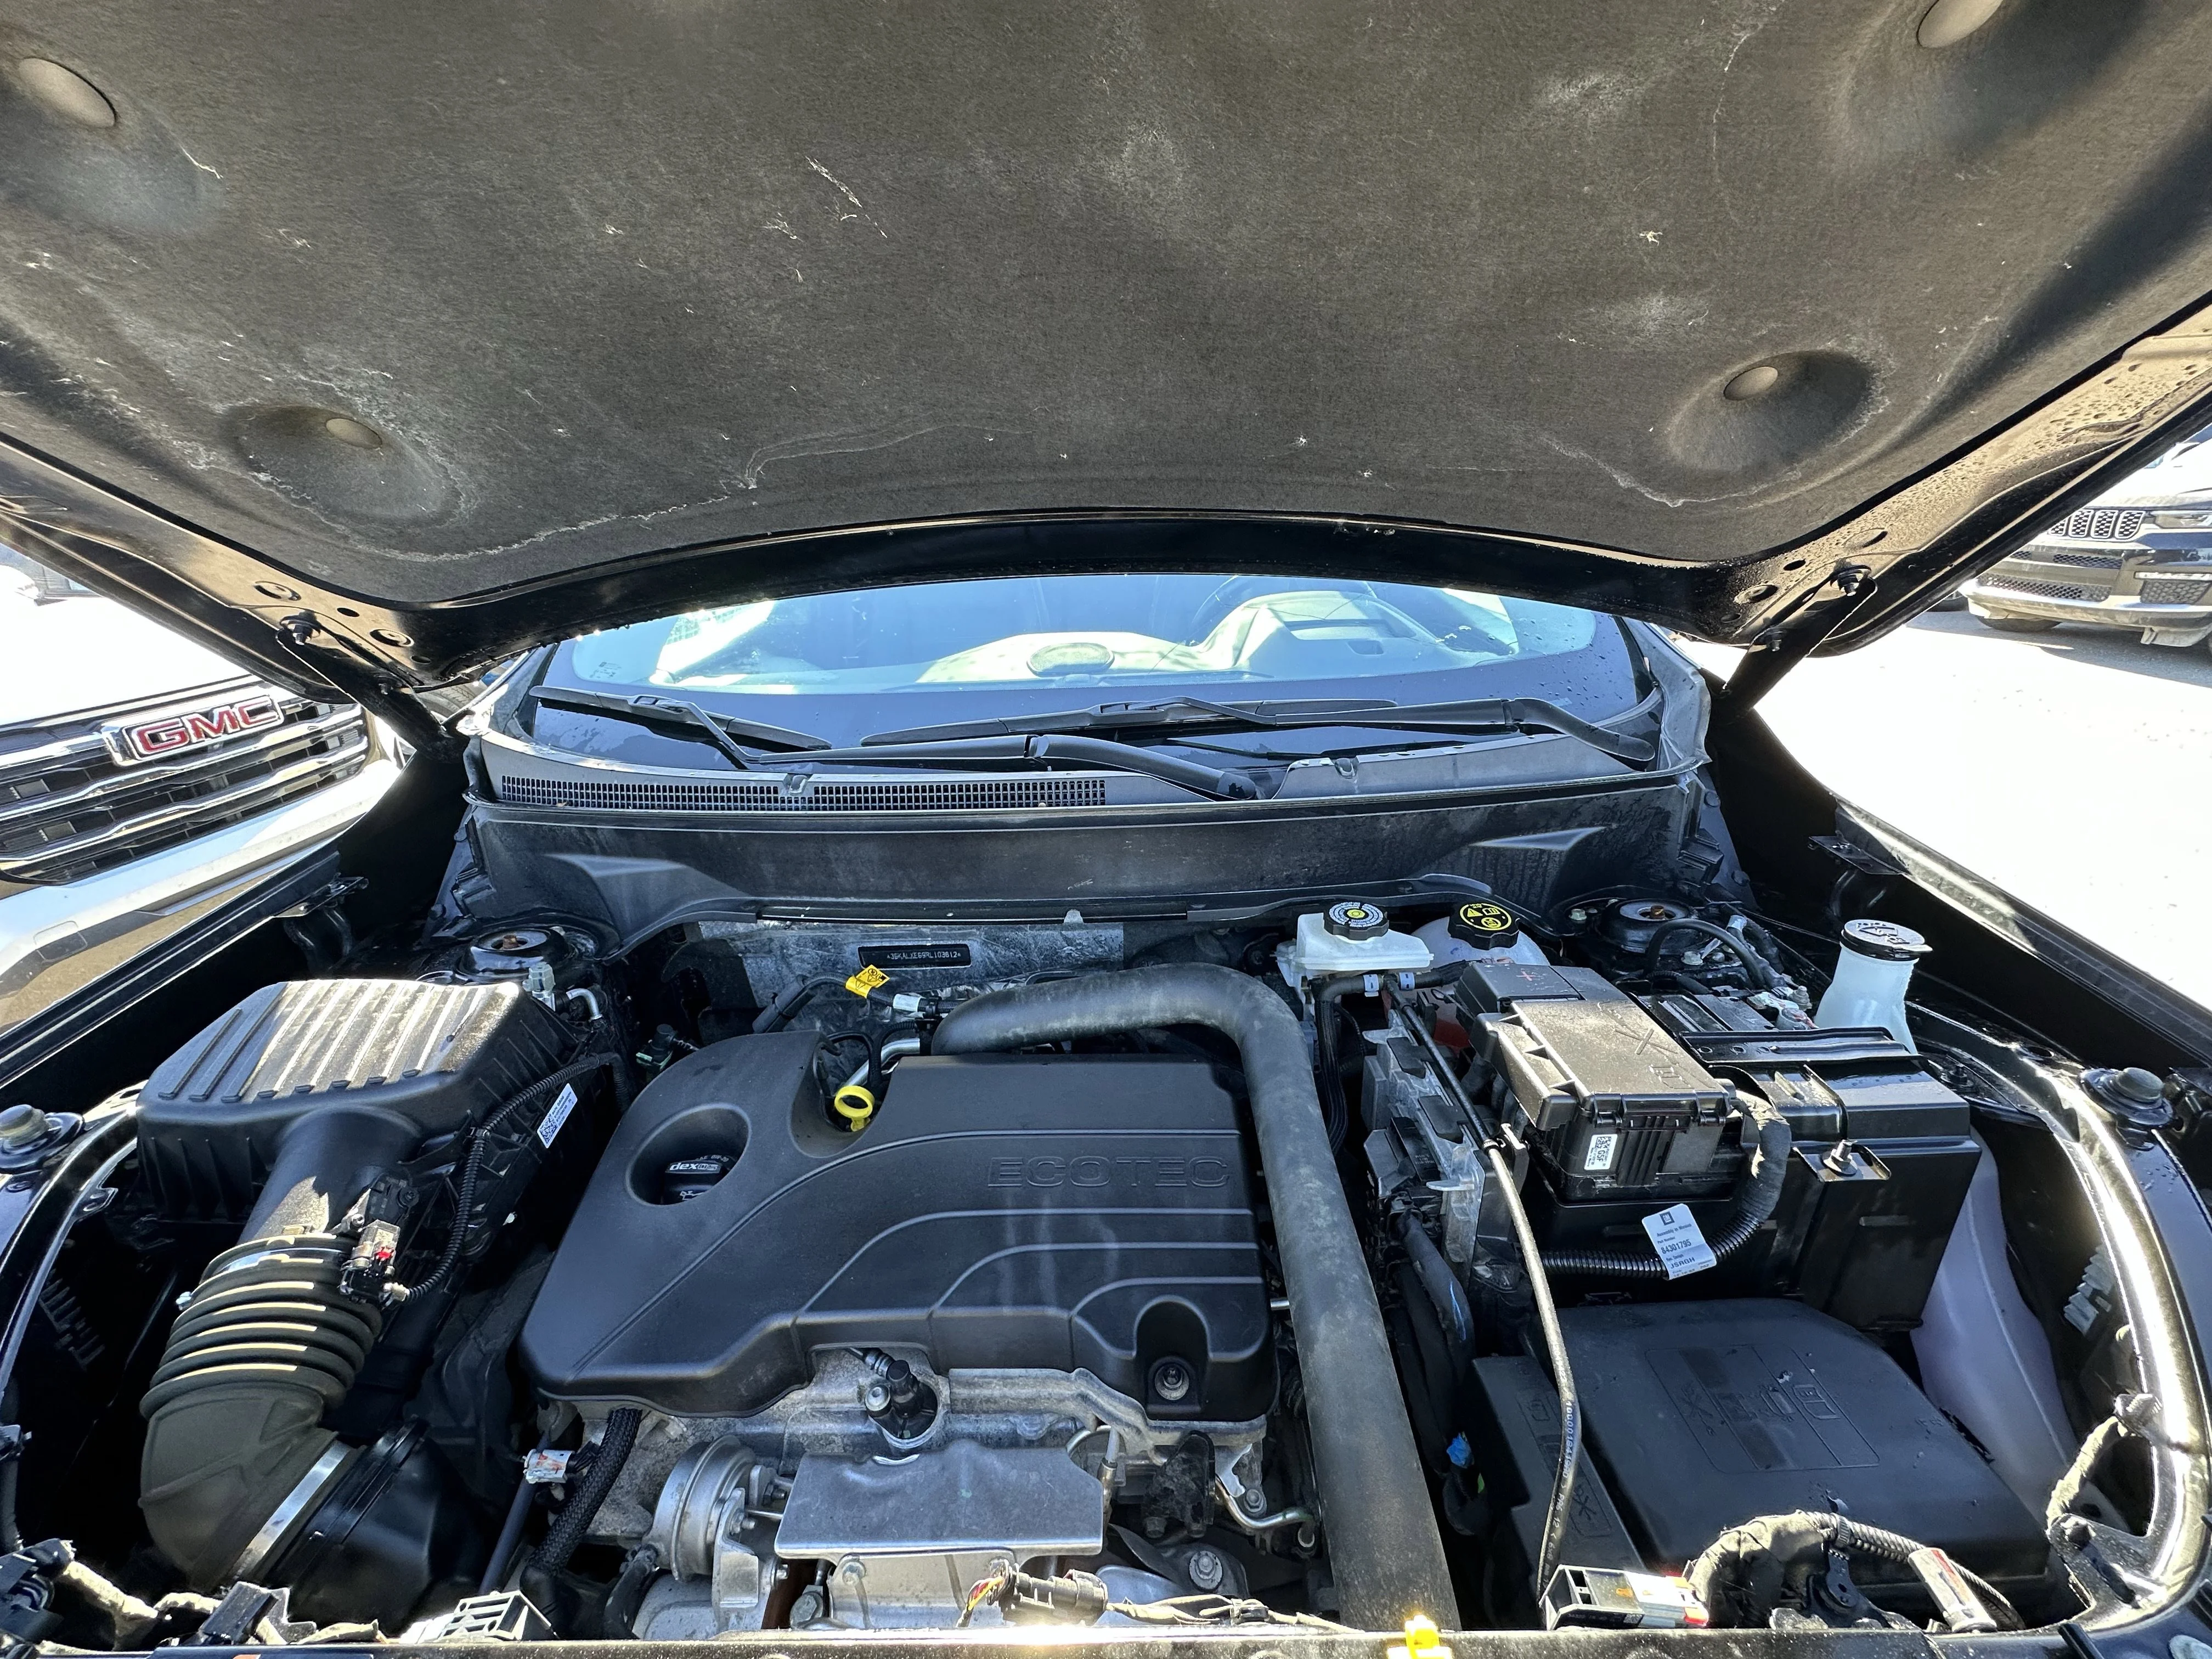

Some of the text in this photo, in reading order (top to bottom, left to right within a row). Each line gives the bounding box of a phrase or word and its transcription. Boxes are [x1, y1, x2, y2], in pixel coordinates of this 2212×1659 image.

[133, 696, 279, 754] GMC
[1596, 1150, 1605, 1161] G5F
[669, 1163, 718, 1171] dexos
[988, 1156, 1229, 1187] ECOTEC
[1661, 1239, 1691, 1254] 84301795
